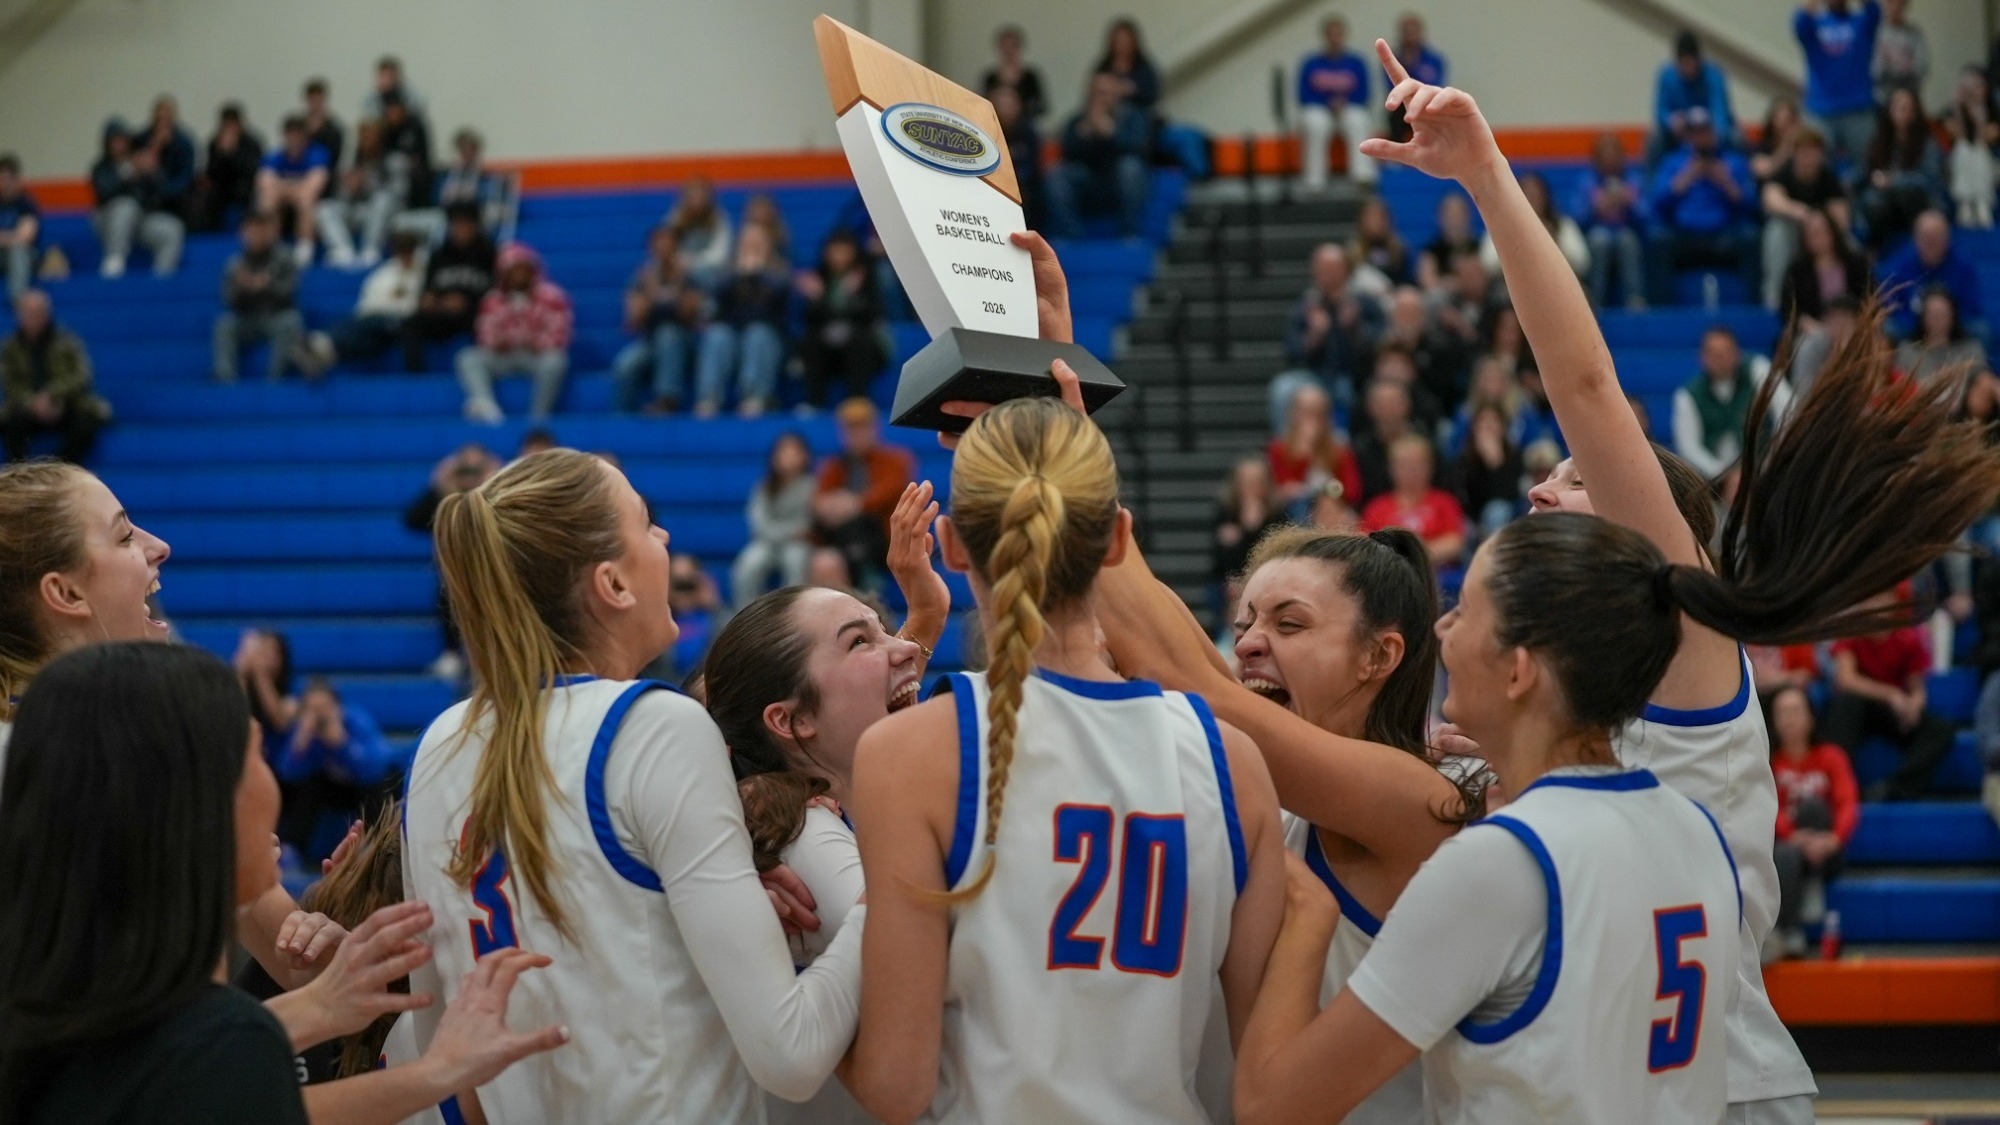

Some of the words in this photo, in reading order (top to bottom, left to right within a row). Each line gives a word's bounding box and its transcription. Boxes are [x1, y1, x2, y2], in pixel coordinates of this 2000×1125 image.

[900, 111, 914, 119] STATE
[914, 112, 942, 120] UNIVERSITY
[951, 118, 964, 127] NEW
[964, 123, 979, 135] YORK
[907, 122, 980, 153] SUNYAC
[920, 146, 945, 160] ATHLETIC
[945, 155, 978, 165] CONFERENCE
[939, 209, 990, 227] WOMEN'S
[936, 224, 1005, 245] BASKETBALL
[952, 262, 1014, 283] CHAMPIONS
[982, 301, 1006, 315] 2026
[1047, 803, 1189, 979] 20
[1647, 903, 1708, 1074] 5
